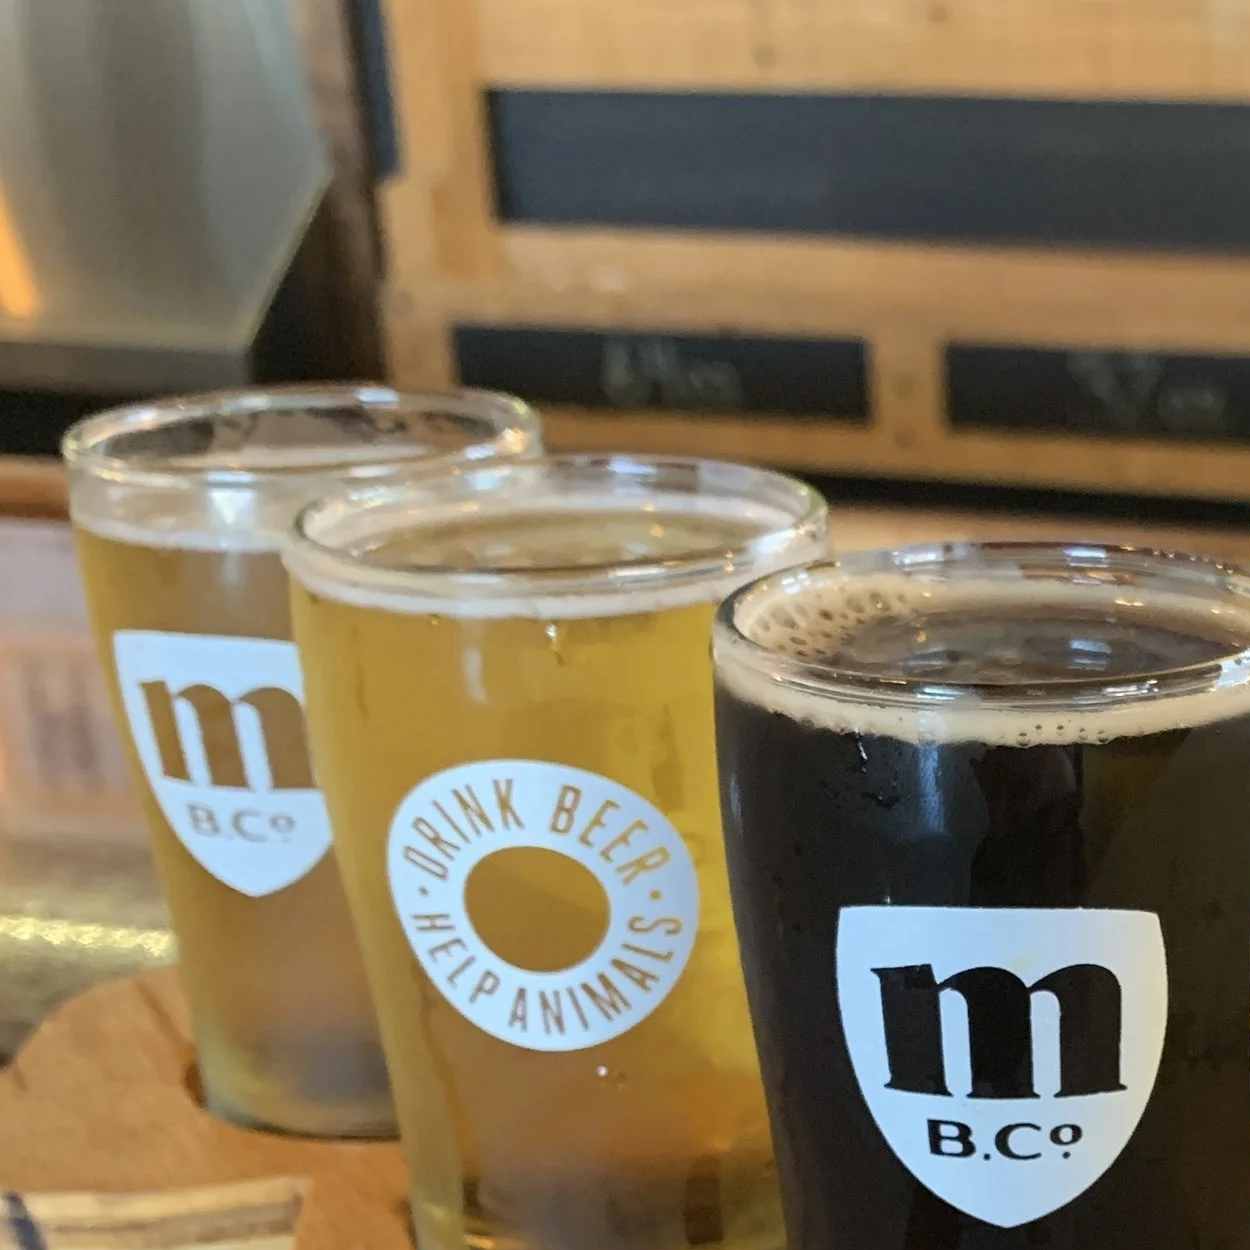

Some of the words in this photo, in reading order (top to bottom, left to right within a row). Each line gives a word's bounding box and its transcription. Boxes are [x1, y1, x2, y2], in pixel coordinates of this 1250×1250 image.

[138, 680, 320, 790] m
[403, 778, 524, 882] DRINK
[549, 784, 671, 885] BEER
[412, 912, 500, 1004] HELP
[508, 915, 682, 1035] ANIMALS
[870, 963, 1128, 1100] m
